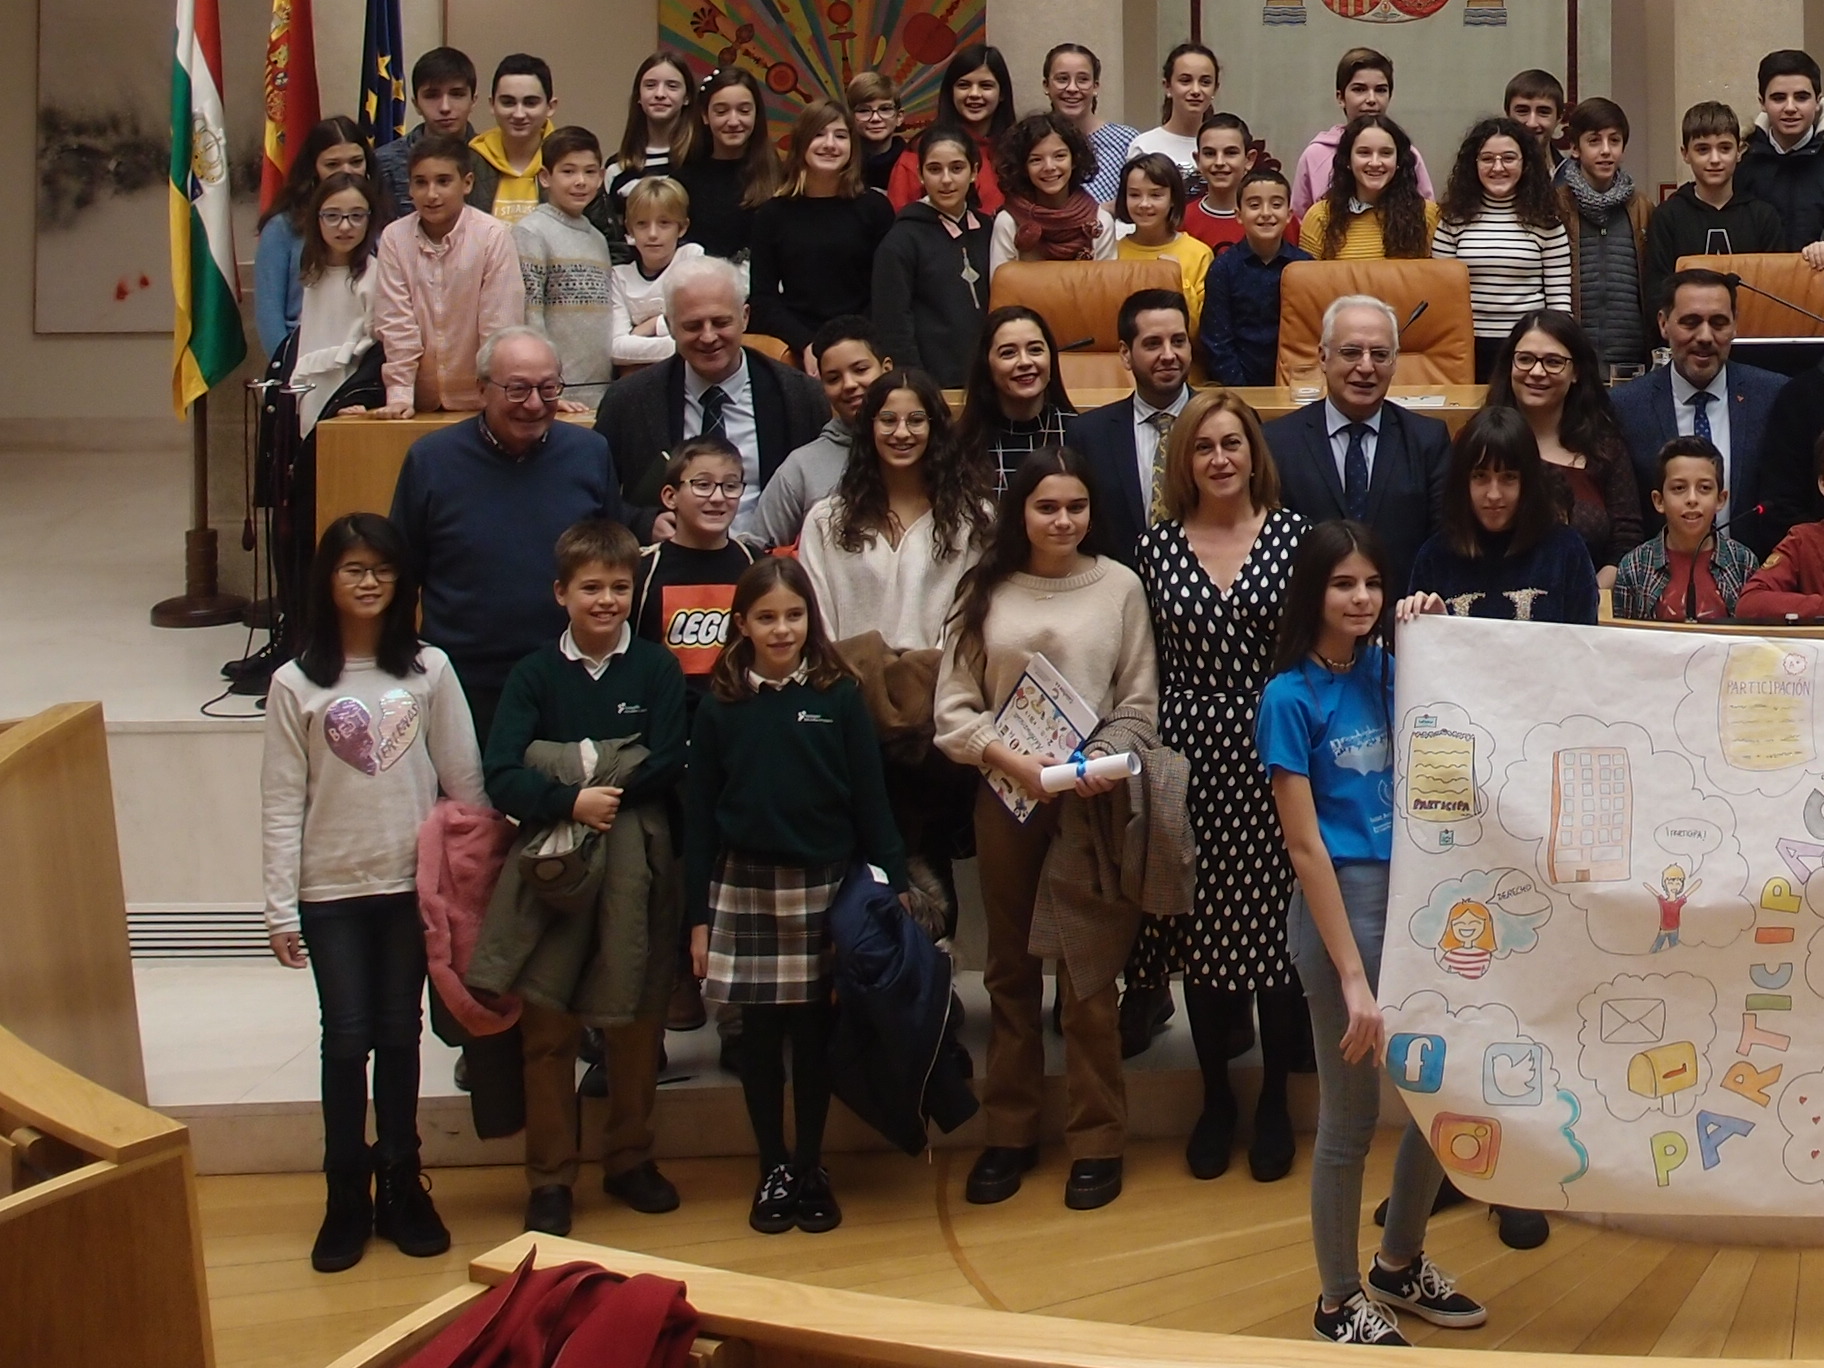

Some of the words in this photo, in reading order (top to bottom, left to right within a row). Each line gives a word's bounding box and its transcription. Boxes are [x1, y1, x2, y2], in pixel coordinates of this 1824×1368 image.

[1727, 679, 1811, 696] PARTICIPACIÓN
[1413, 798, 1471, 812] PARTICIPA
[1497, 883, 1532, 901] DERECHO
